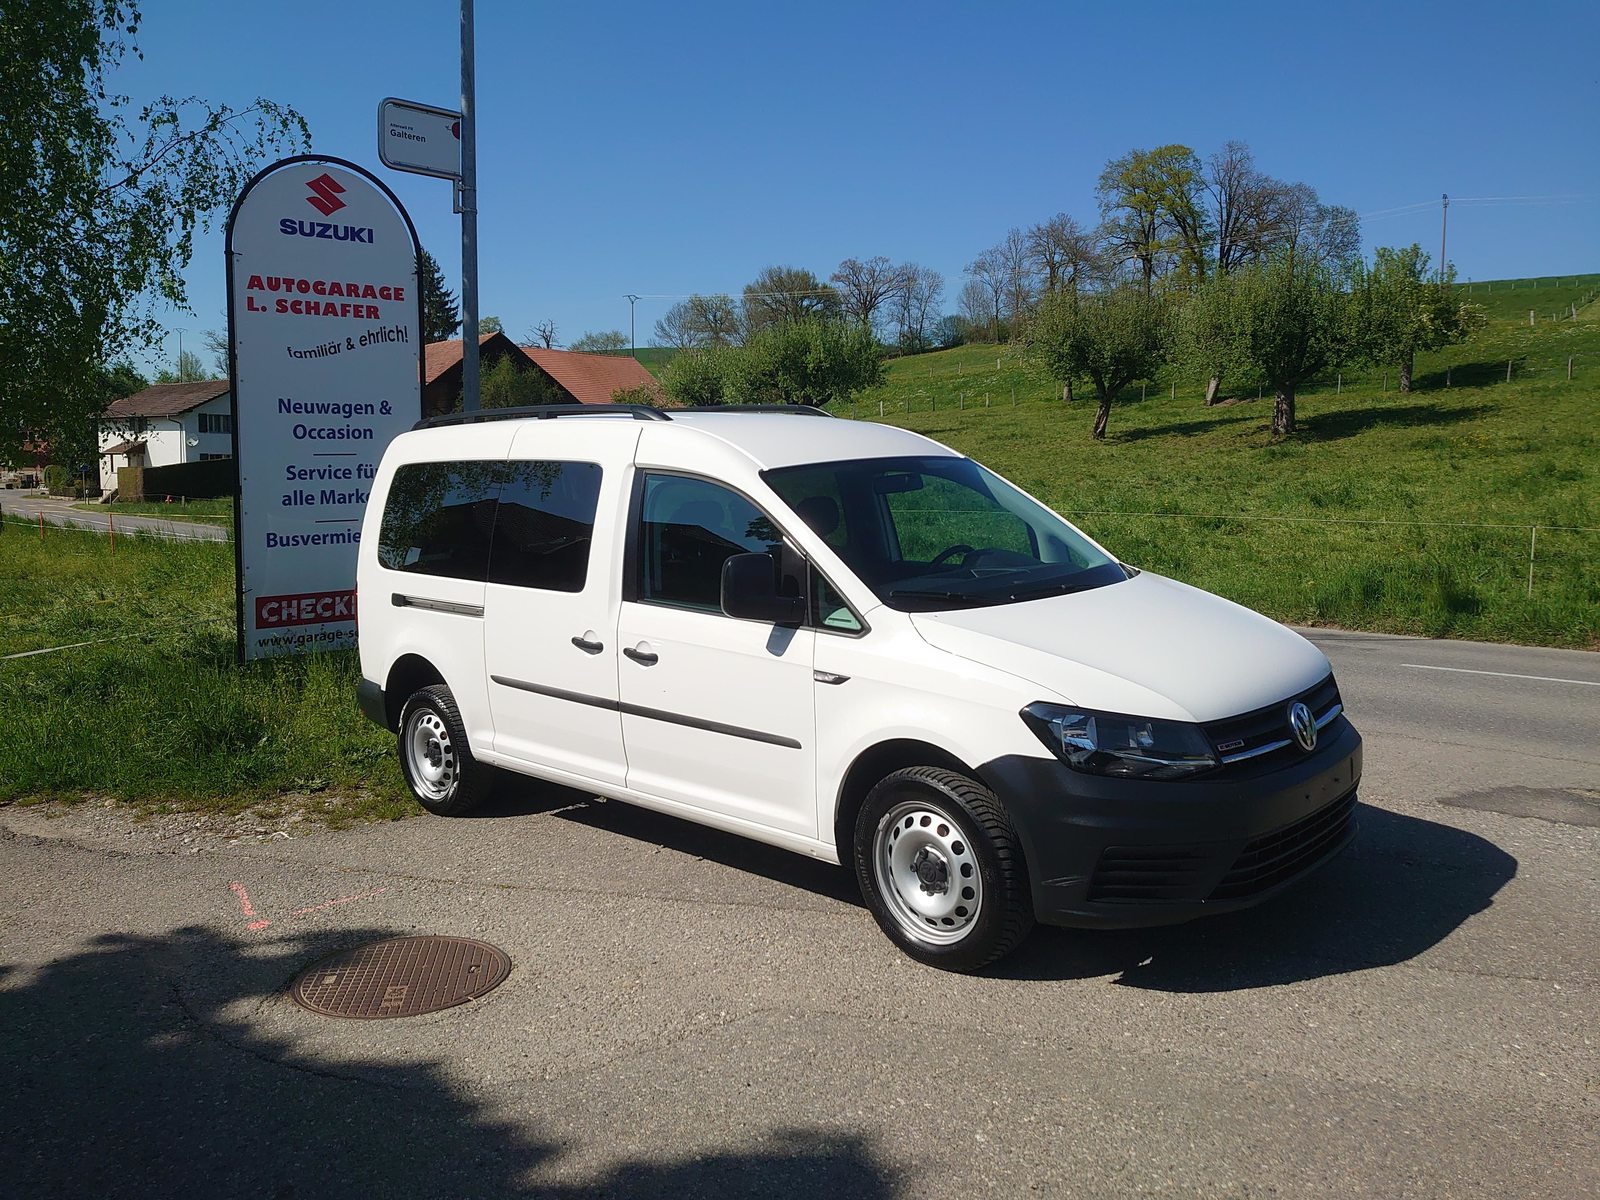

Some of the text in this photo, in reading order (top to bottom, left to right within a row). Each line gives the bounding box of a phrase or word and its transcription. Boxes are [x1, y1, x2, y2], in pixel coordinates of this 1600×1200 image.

[390, 129, 426, 143] Galteren
[279, 218, 374, 244] SUZUKI
[247, 275, 405, 301] AUTOGARAGE
[247, 297, 268, 312] L.
[287, 325, 409, 359] familiär & ehrlich!
[278, 398, 392, 418] Neuwagen &
[292, 424, 374, 440] Occasion
[286, 464, 352, 481] Service
[281, 490, 315, 506] alle
